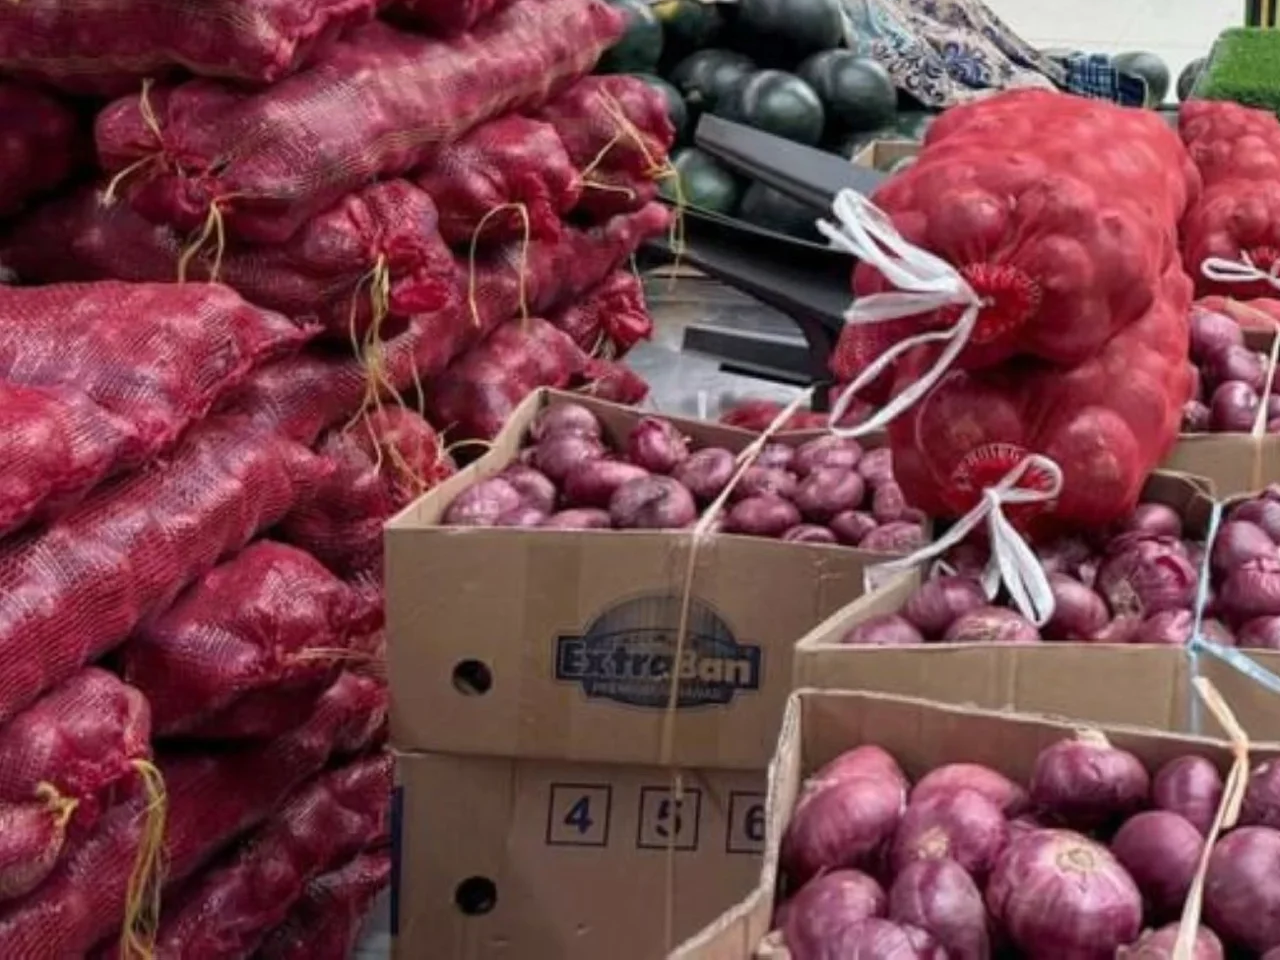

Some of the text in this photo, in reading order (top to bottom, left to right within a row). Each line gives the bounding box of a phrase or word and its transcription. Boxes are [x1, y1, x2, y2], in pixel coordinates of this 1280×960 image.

[564, 795, 766, 841] 4 5 6
